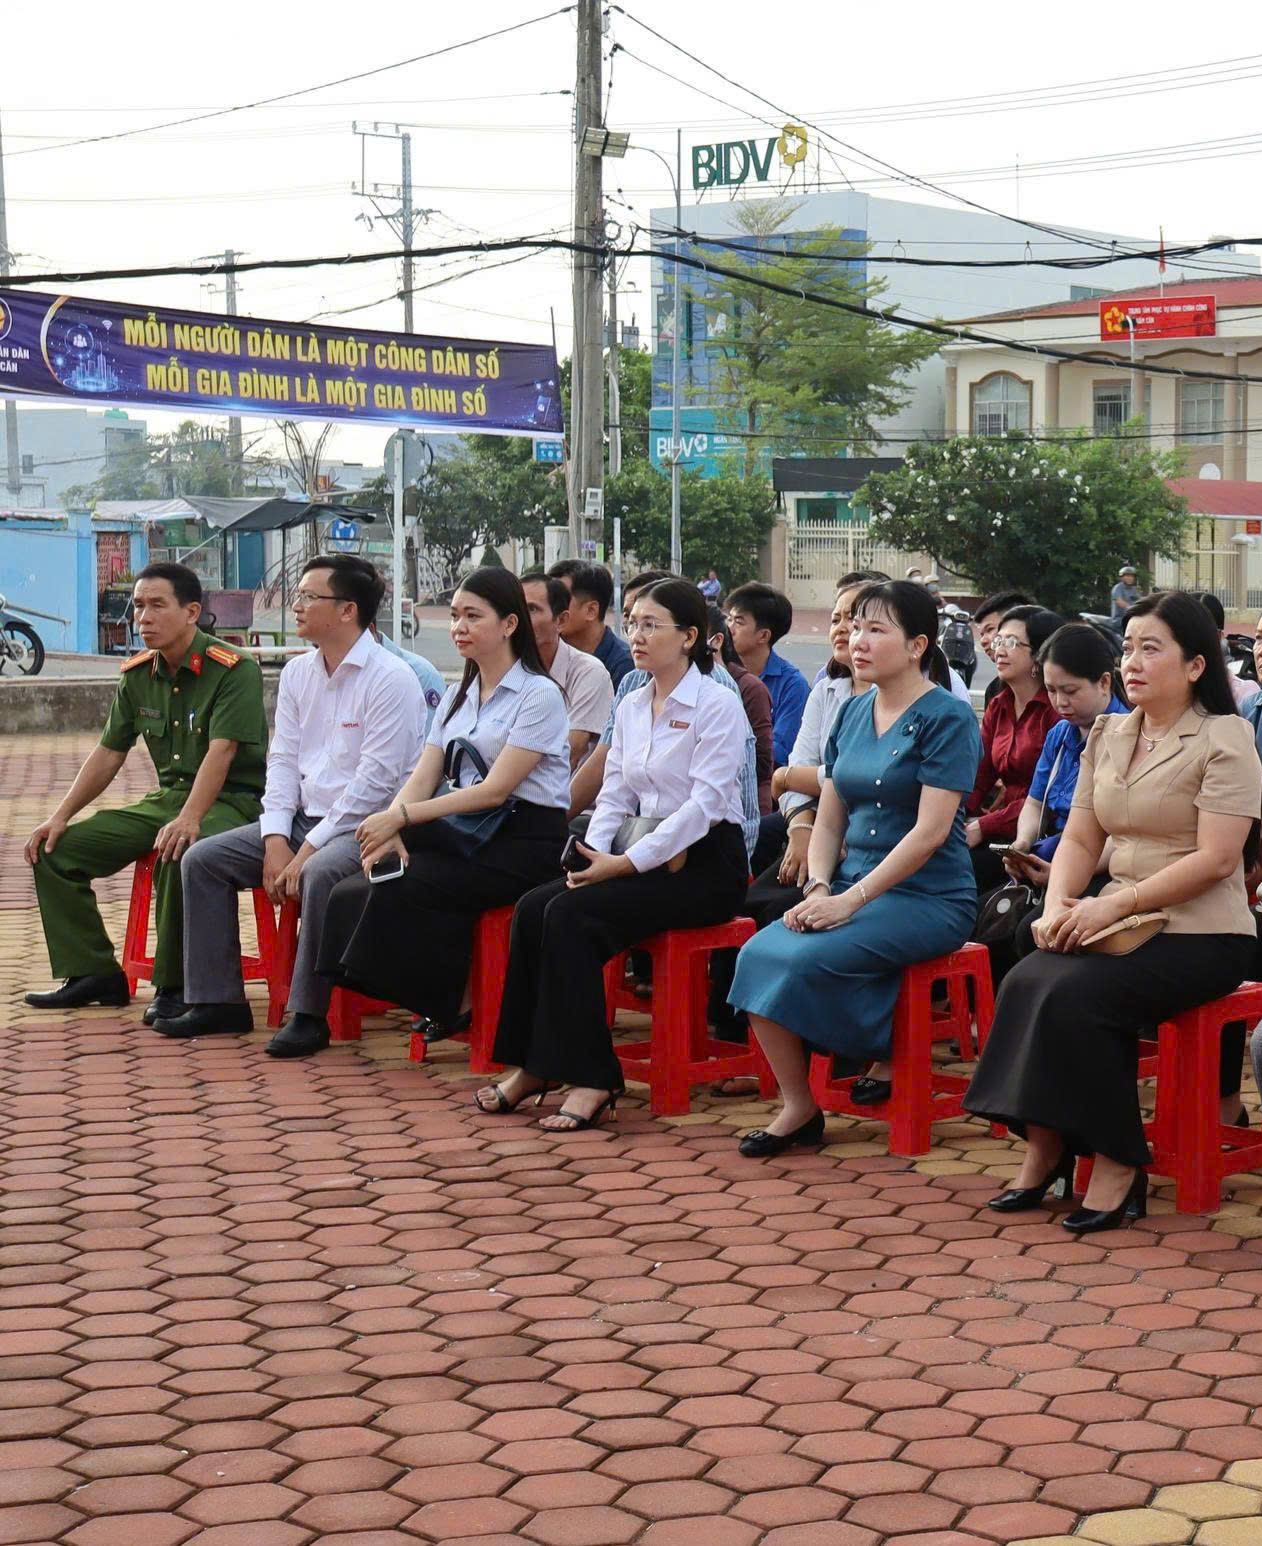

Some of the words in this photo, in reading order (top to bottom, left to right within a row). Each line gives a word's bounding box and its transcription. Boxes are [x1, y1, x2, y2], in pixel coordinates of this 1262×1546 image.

[692, 136, 779, 190] BIDV
[11, 346, 30, 360] DÂN
[123, 312, 168, 348] MỖI
[174, 322, 240, 356] NGƯỜI
[247, 327, 290, 360] DÂN
[296, 332, 321, 363] LÀ
[326, 336, 369, 372] MỘT
[374, 340, 427, 373] CÔNG
[431, 346, 470, 377] DÂN
[475, 347, 500, 379] SỐ
[146, 356, 190, 393] MỖI
[196, 368, 233, 397] GIA
[238, 368, 289, 401] ĐÌNH
[295, 373, 320, 404] LÀ
[325, 376, 368, 412] MỘT
[373, 383, 406, 410] GIA
[411, 382, 457, 414] ĐÌNH
[462, 384, 487, 416] SỐ
